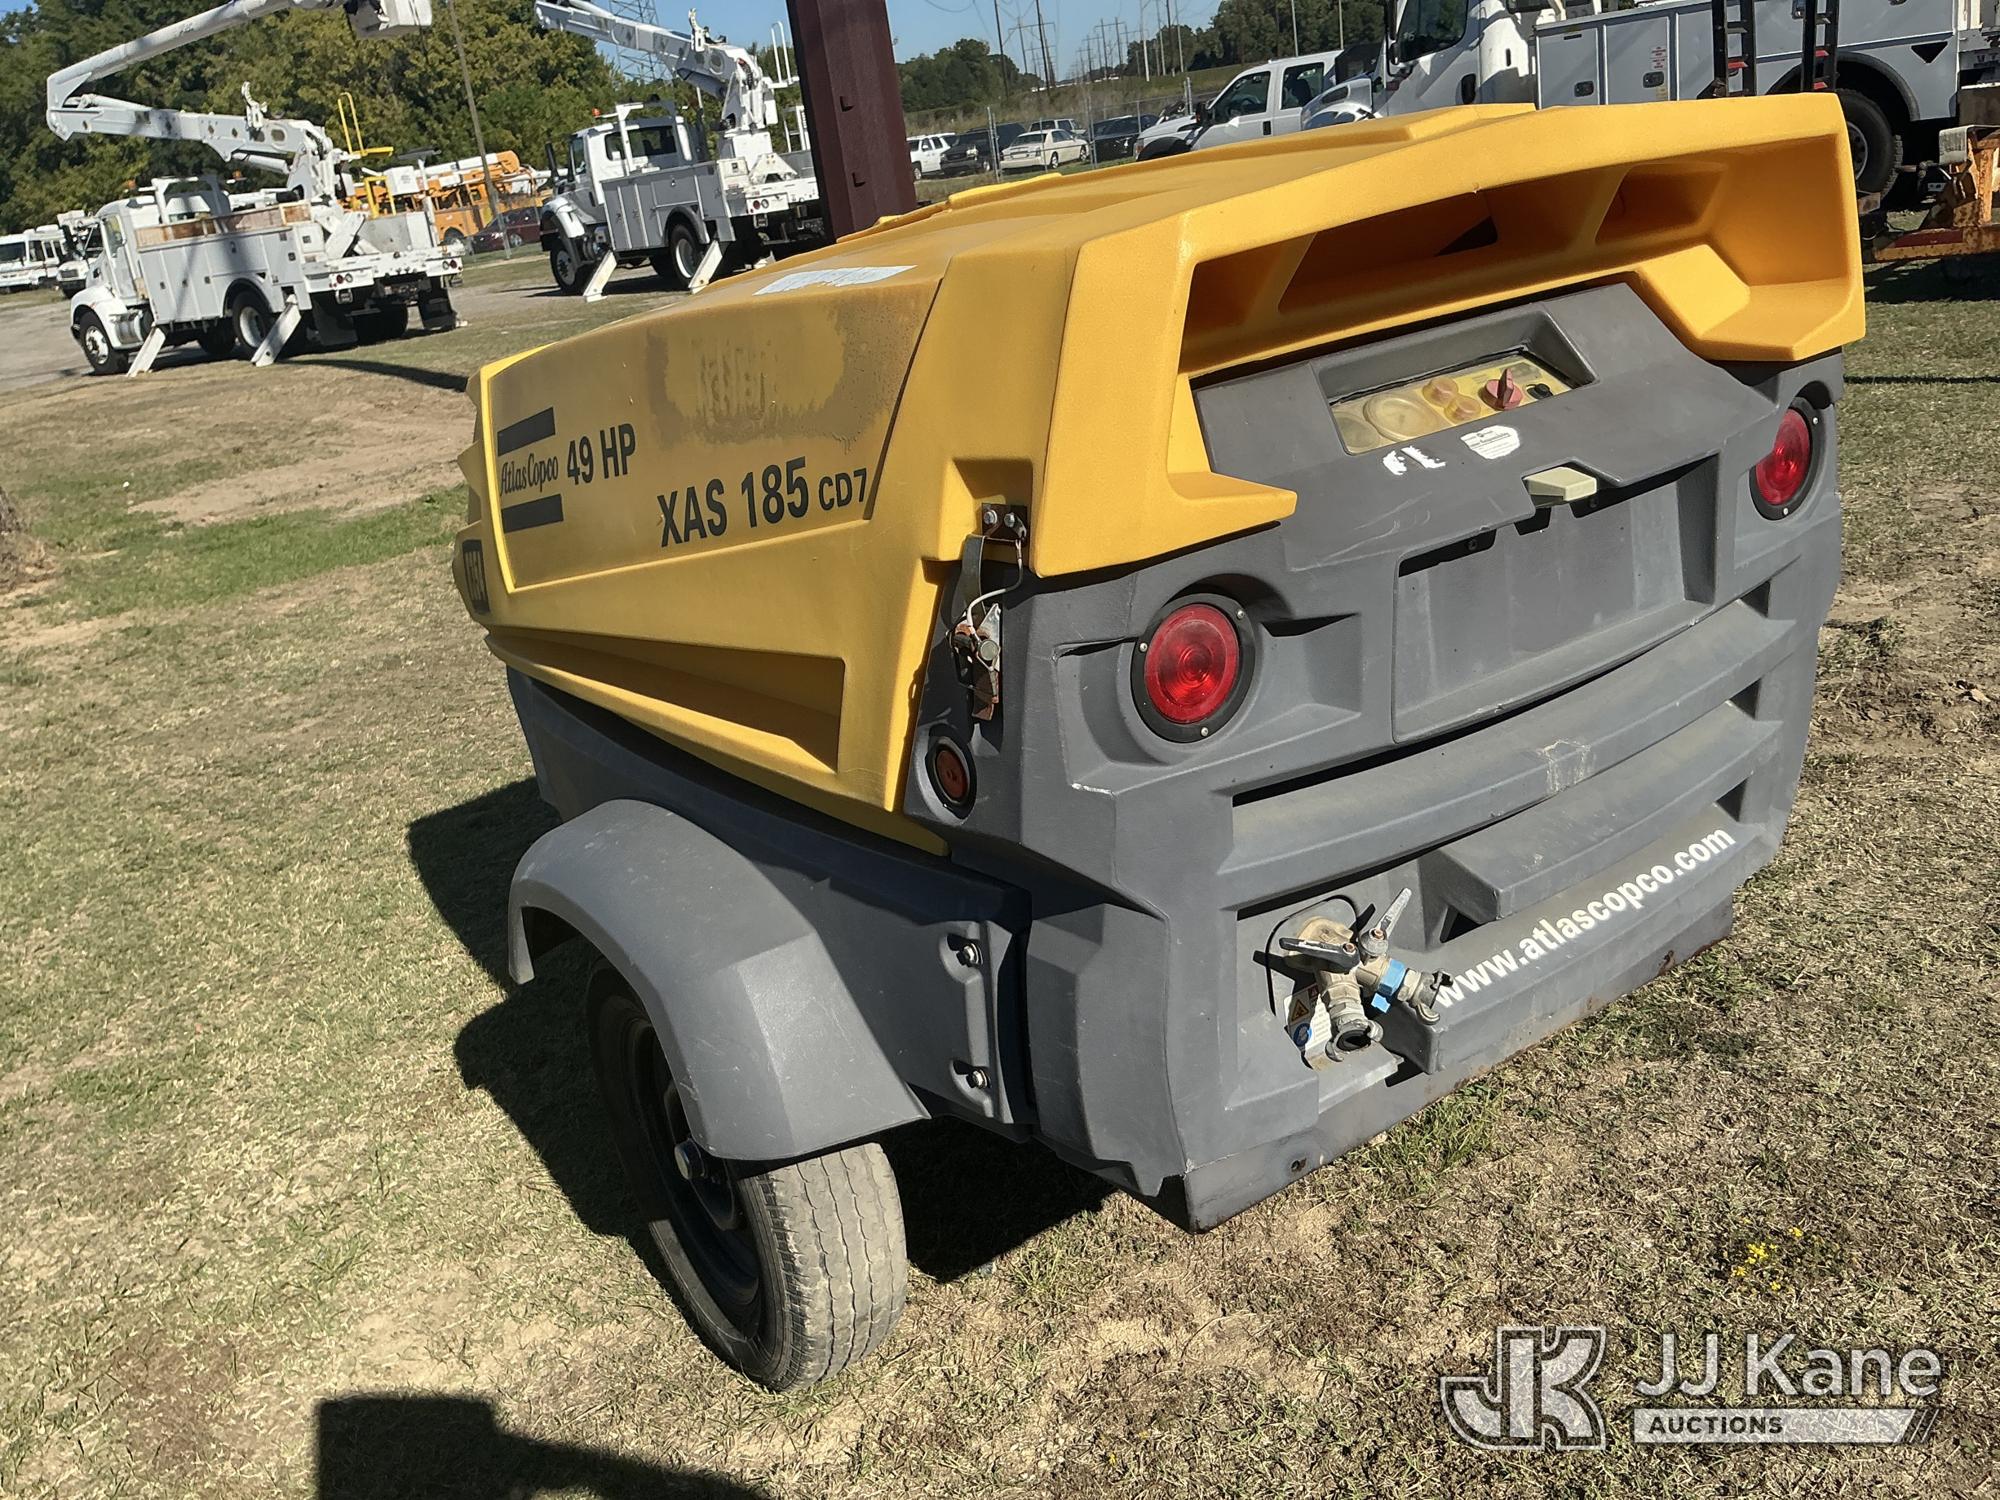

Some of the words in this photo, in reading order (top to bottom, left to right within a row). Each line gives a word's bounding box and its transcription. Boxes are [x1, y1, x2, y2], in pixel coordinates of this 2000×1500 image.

[567, 436, 594, 486] 49
[600, 423, 636, 479] HP
[657, 478, 728, 547] XAS
[741, 456, 809, 528] 185
[819, 468, 867, 511] CD7
[1435, 827, 1737, 1008] www.atlascopco.com
